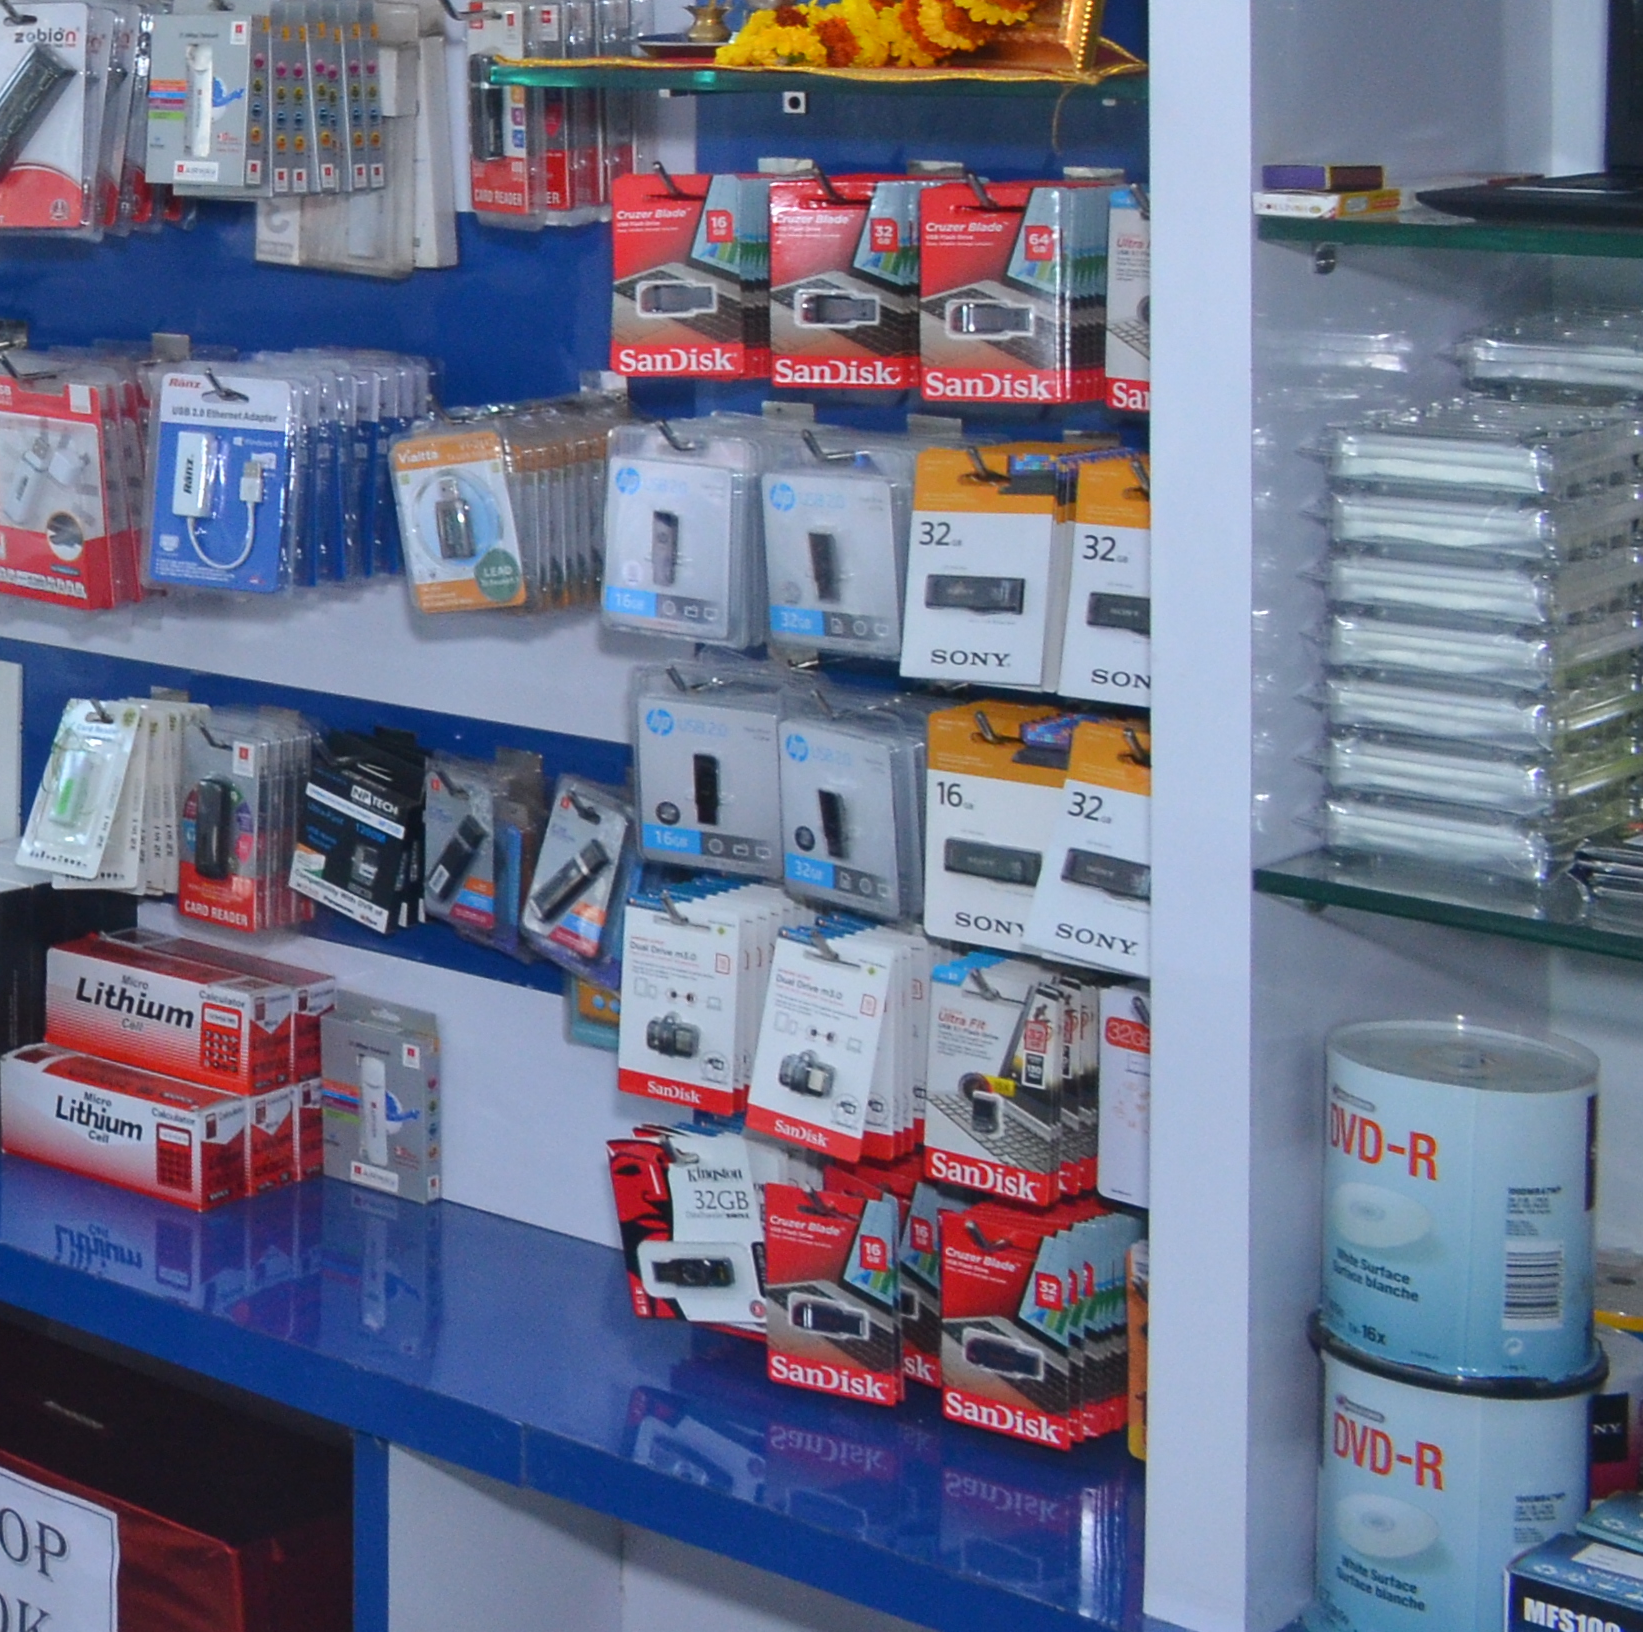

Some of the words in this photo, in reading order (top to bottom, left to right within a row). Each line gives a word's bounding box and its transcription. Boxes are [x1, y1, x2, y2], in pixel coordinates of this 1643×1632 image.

[617, 210, 653, 221] Cruzer
[655, 208, 687, 218] Blade
[711, 217, 727, 229] 16
[875, 225, 893, 238] 32
[925, 222, 966, 232] Cruzer
[968, 222, 1003, 232] Blade
[1029, 234, 1051, 245] 64
[619, 348, 734, 372] SanDisk
[774, 358, 901, 385] SanDisk
[925, 372, 1052, 400] SanDisk
[931, 649, 1011, 667] SONY
[1091, 669, 1151, 689] SON
[1055, 923, 1138, 956] SONY
[121, 974, 150, 992] Micro
[75, 976, 194, 1029] Lithium
[198, 989, 246, 1010] Calculator
[121, 1016, 144, 1032] Cell
[83, 1091, 113, 1107] Micro
[647, 1080, 701, 1105] SanDisk
[54, 1095, 144, 1142] Lithium
[151, 1106, 197, 1126] Calculator
[87, 1128, 110, 1145] Cell
[774, 1119, 828, 1148] SanDisk
[1330, 1102, 1439, 1182] DVD-R
[687, 1168, 743, 1182] Kingston
[931, 1153, 1038, 1202] SanDisk
[695, 1189, 750, 1211] 32GB
[770, 1215, 807, 1232] Cruzer
[808, 1222, 841, 1236] Blade
[864, 1241, 881, 1256] 16
[945, 1247, 981, 1262] Cruzer
[983, 1256, 1016, 1272] Blade
[1039, 1280, 1057, 1296] 32
[771, 1354, 887, 1401] SanDisk
[945, 1391, 1061, 1445] SanDisk
[1592, 1424, 1623, 1434] NY
[1333, 1412, 1444, 1492] DVD-R
[1370, 1568, 1418, 1595] Surface
[1375, 1583, 1425, 1612] blanche
